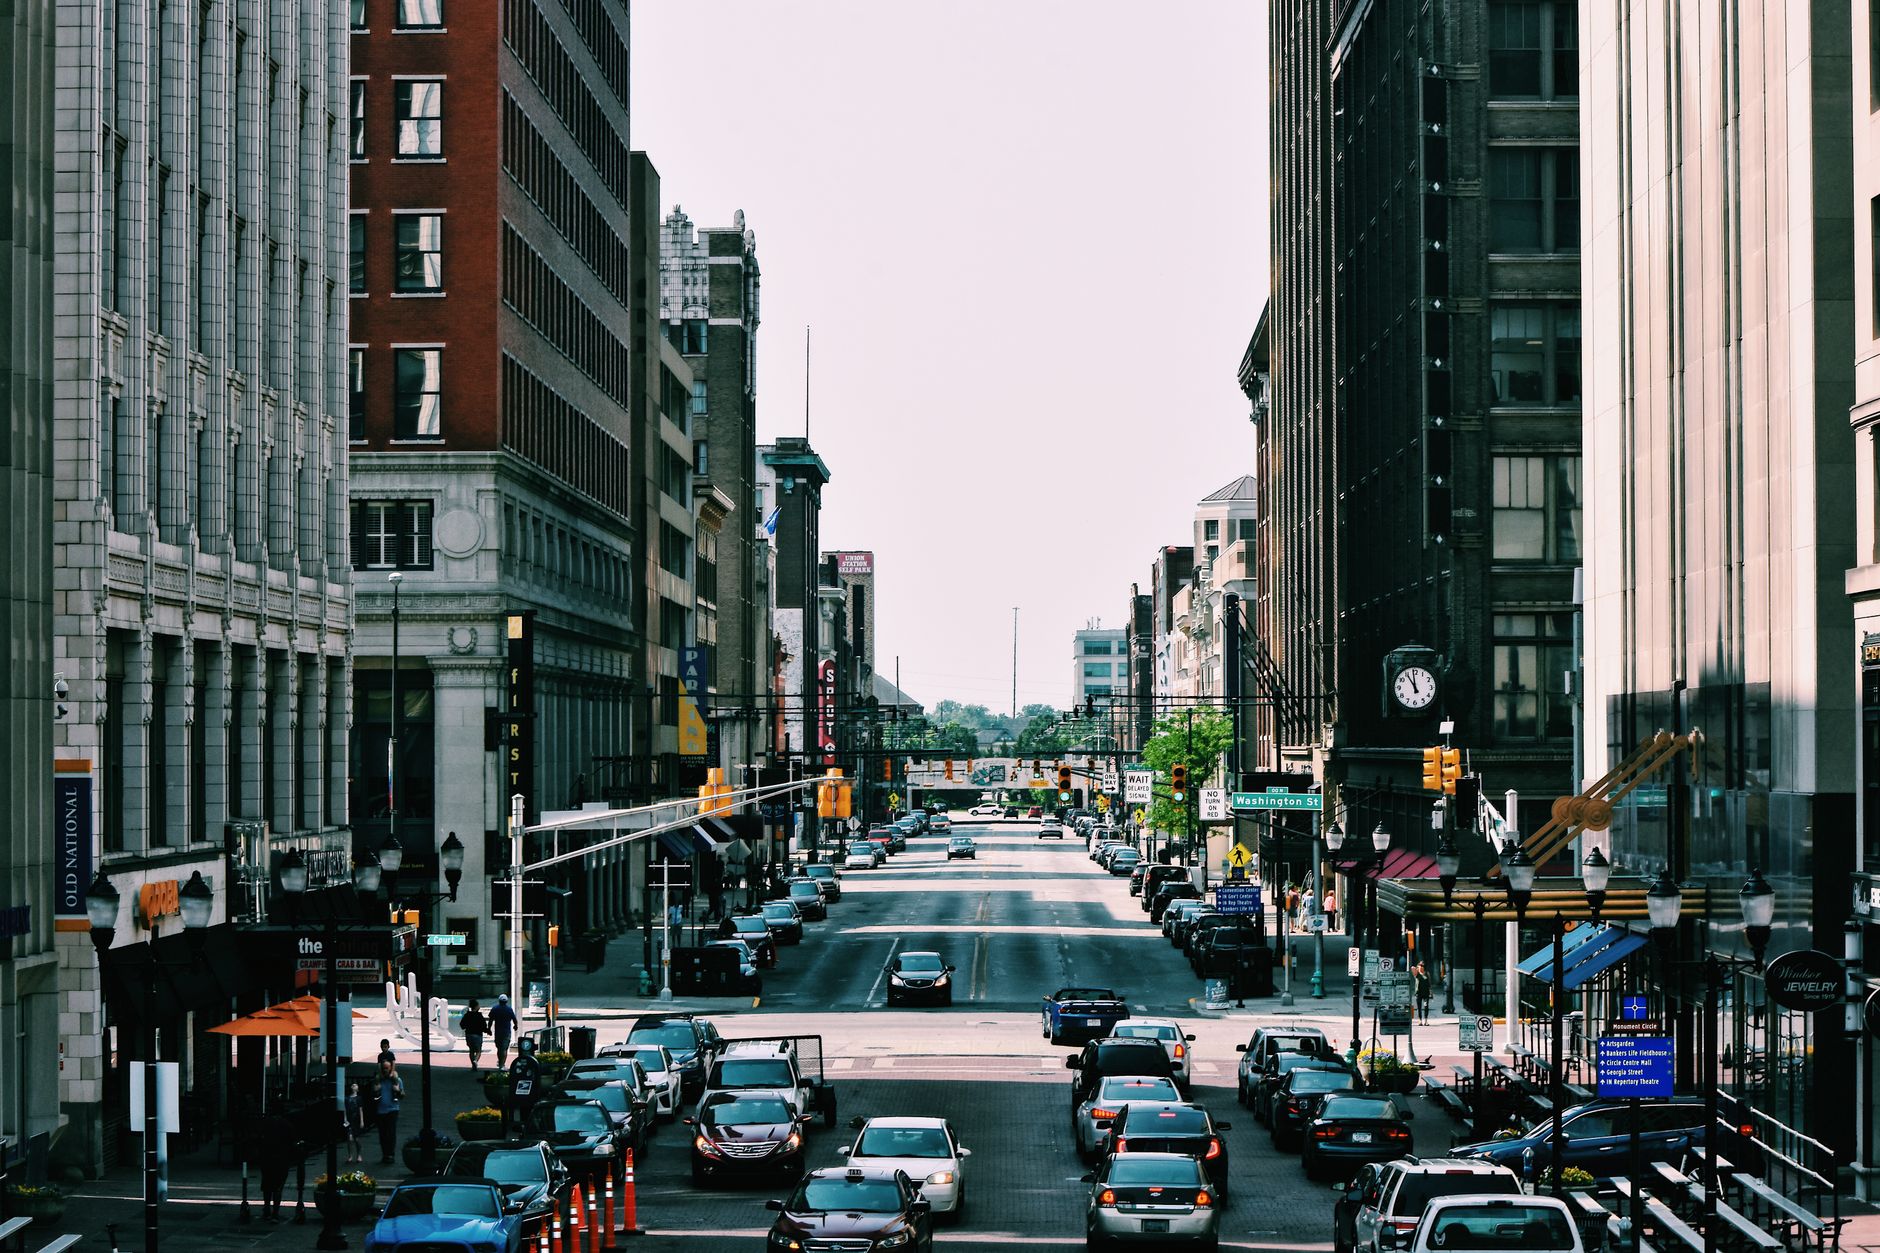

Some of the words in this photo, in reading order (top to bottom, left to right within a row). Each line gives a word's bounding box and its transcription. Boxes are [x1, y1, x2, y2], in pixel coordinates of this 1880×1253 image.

[686, 651, 699, 752] PARKING
[1129, 775, 1150, 784] WAIT
[1236, 796, 1302, 807] Washington
[1306, 797, 1319, 806] St
[66, 787, 78, 869] NATIONAL
[66, 873, 78, 907] OLD
[298, 937, 323, 954] the
[434, 935, 455, 945] Court
[338, 960, 353, 969] CRAB
[355, 960, 361, 969] &
[1773, 965, 1823, 980] Windsor
[1783, 981, 1838, 992] JEWELRY
[1613, 1078, 1639, 1086] Repertory
[848, 1168, 862, 1176] TAXI
